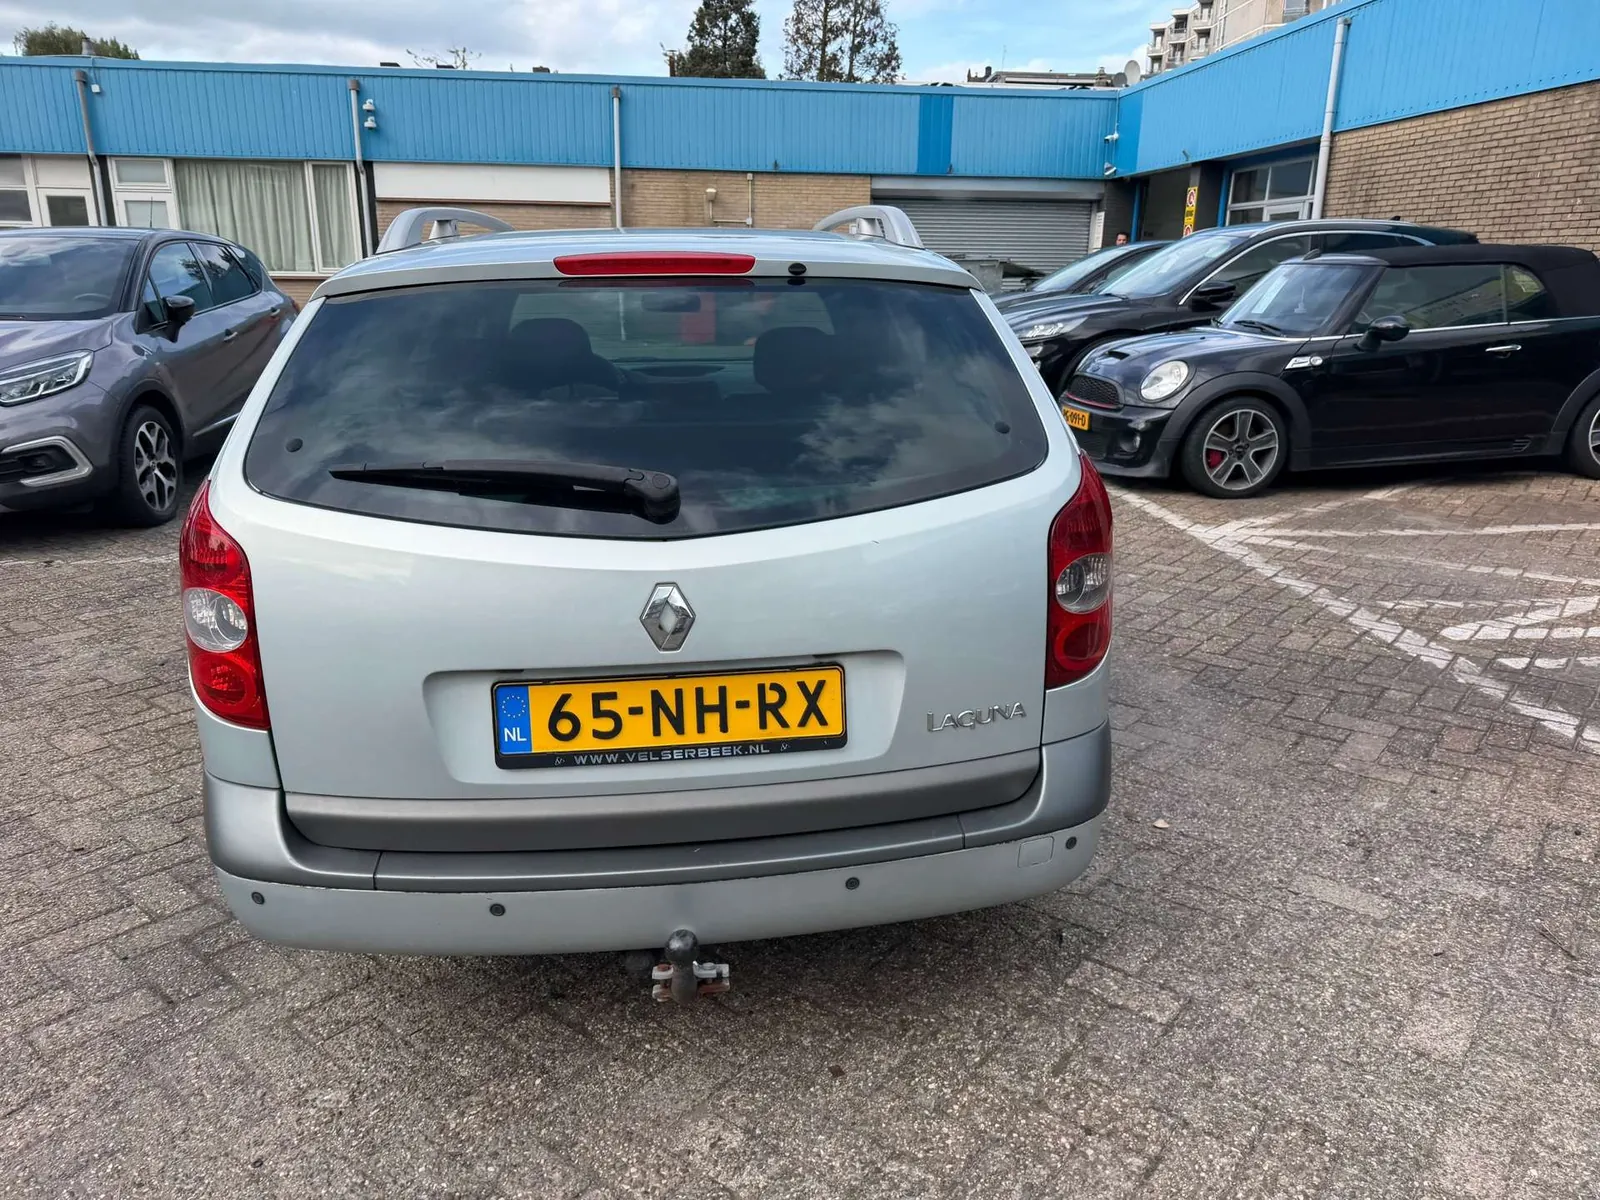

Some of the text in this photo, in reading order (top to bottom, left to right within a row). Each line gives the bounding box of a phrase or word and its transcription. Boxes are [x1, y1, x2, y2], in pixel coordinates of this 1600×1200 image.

[548, 680, 829, 742] 65-NH-RX
[926, 702, 1027, 732] LAGUNA
[504, 727, 527, 742] NL
[574, 745, 770, 765] WWW.VELSERBEEK.NL
